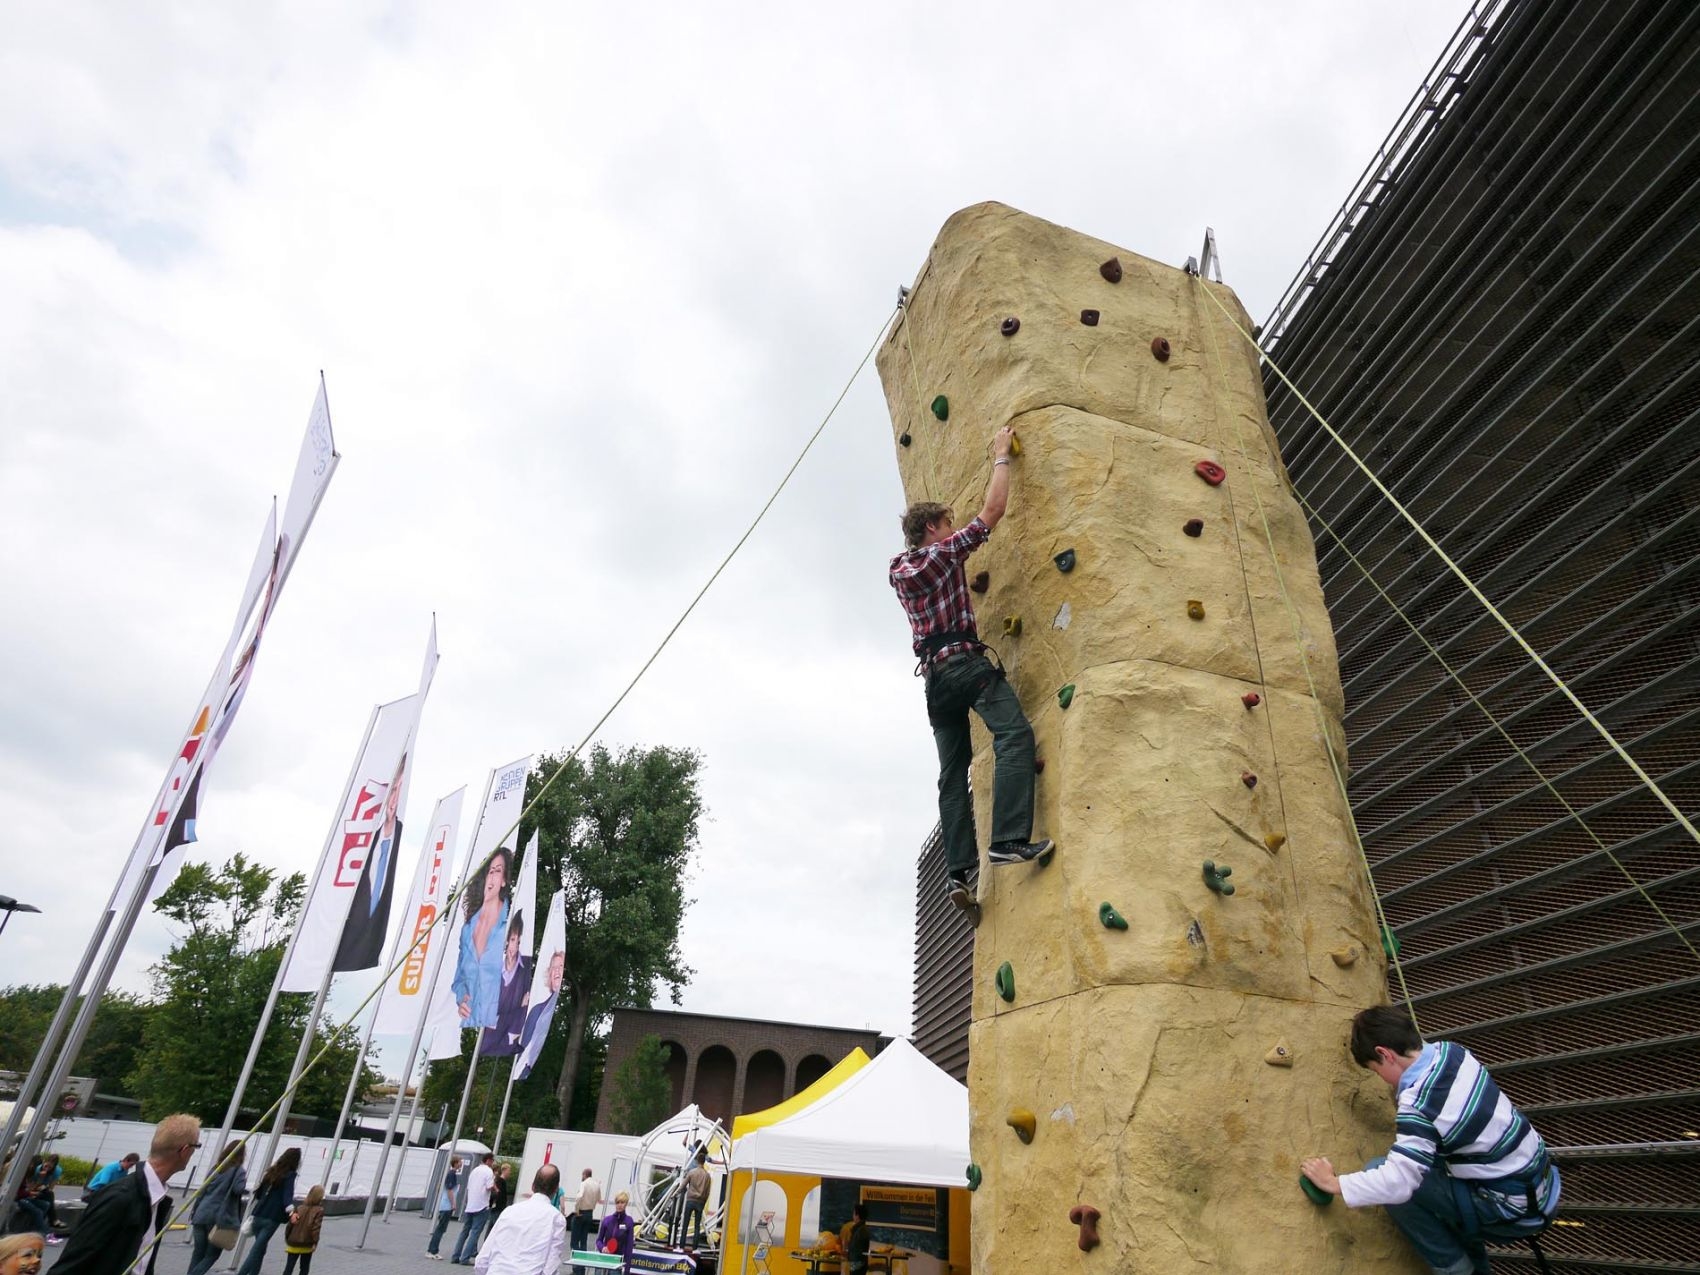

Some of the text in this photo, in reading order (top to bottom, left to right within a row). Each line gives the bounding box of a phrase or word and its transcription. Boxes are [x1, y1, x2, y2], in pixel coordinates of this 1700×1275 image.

[494, 790, 507, 802] RTL
[405, 830, 446, 989] SUPER RTL
[630, 1258, 676, 1271] ertelsmann
